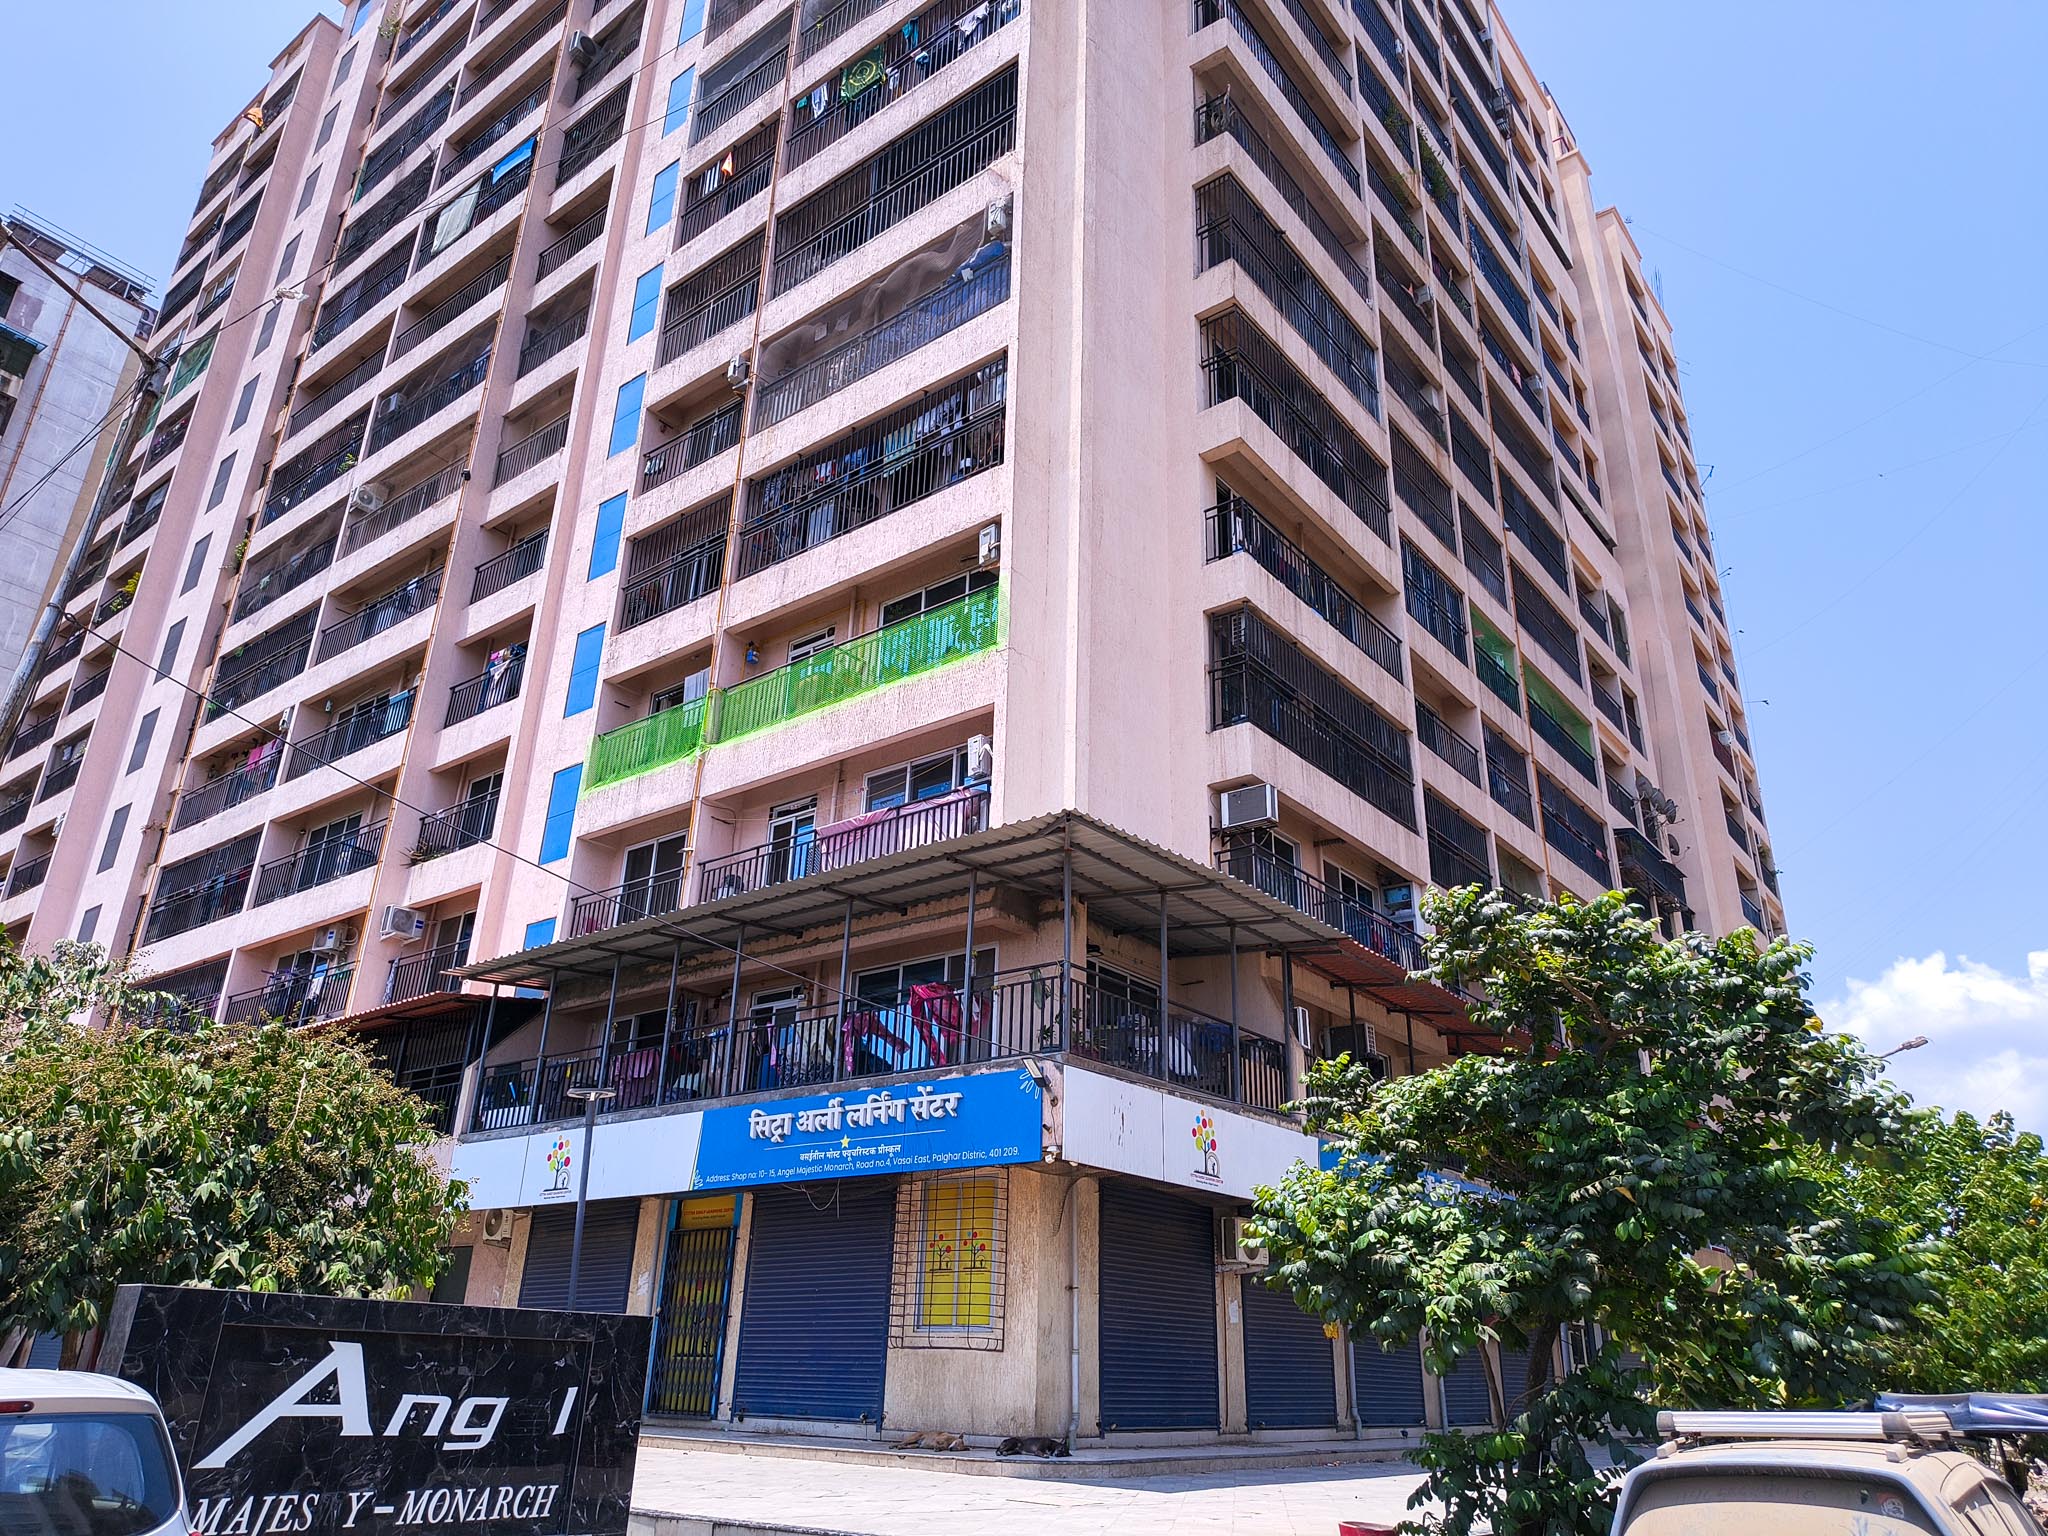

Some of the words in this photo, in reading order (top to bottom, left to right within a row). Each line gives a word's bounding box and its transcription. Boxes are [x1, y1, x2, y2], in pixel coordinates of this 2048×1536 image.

[796, 1096, 845, 1133] अर्ली
[845, 1090, 908, 1128] लर्निंग
[908, 1085, 964, 1121] सेंटर
[731, 1171, 749, 1183] Shop
[777, 1166, 796, 1180] Angel
[797, 1163, 823, 1176] Majestic
[824, 1161, 855, 1172] Monarch,
[856, 1158, 875, 1169] Road
[893, 1155, 913, 1166] Vasai
[914, 1154, 931, 1165] East,
[932, 1151, 962, 1164] Palghar
[988, 1147, 1002, 1158] 401
